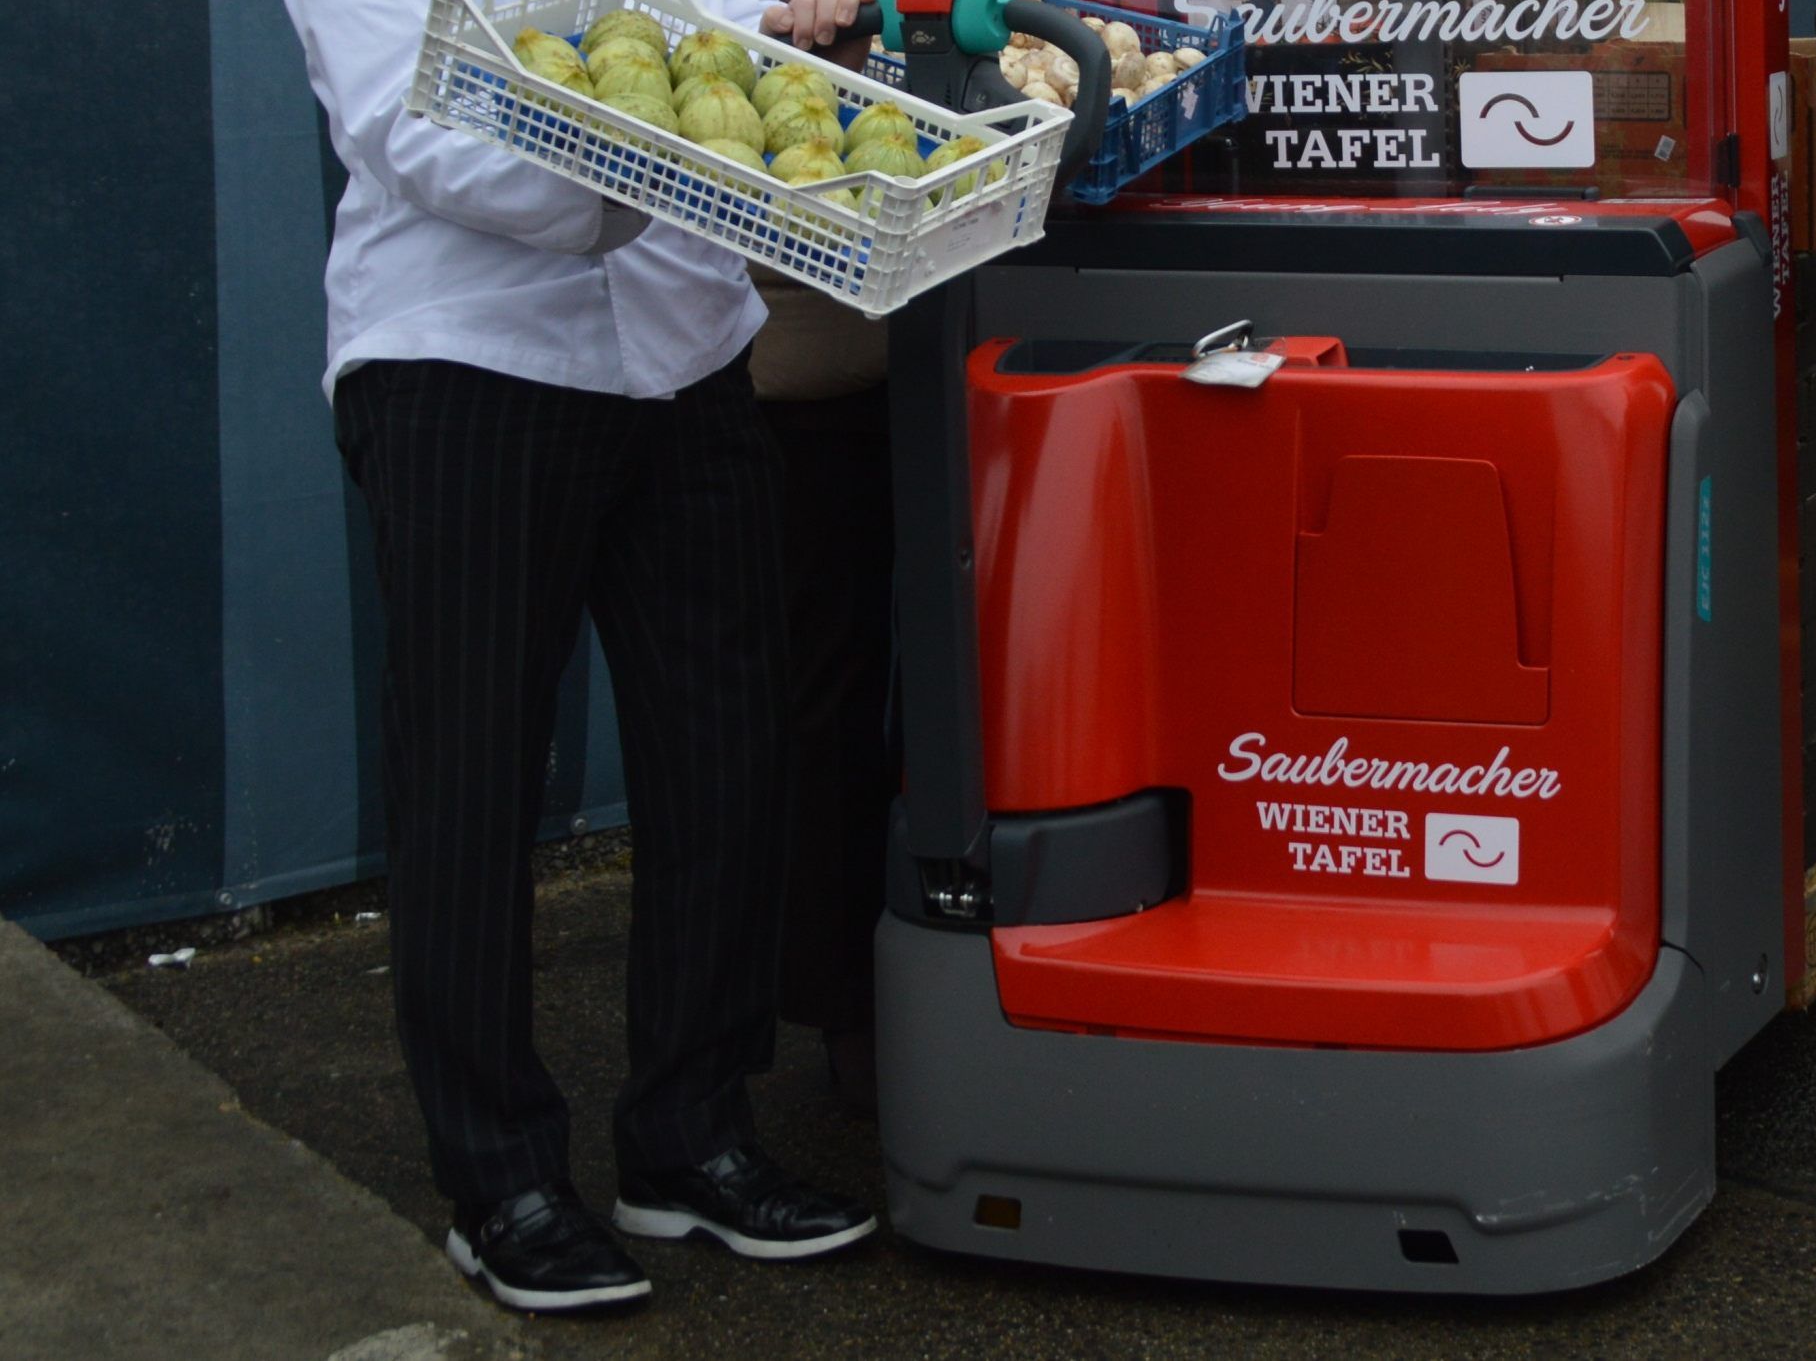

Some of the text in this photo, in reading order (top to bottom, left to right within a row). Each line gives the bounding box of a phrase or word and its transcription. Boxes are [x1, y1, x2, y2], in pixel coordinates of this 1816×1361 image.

[1265, 128, 1441, 169] TAFEL
[1771, 173, 1782, 319] WIENER
[1780, 169, 1790, 285] TAFEL
[1216, 731, 1562, 800] Saubermacher
[1256, 800, 1411, 839] WIENER
[1288, 841, 1411, 877] TAFEL
